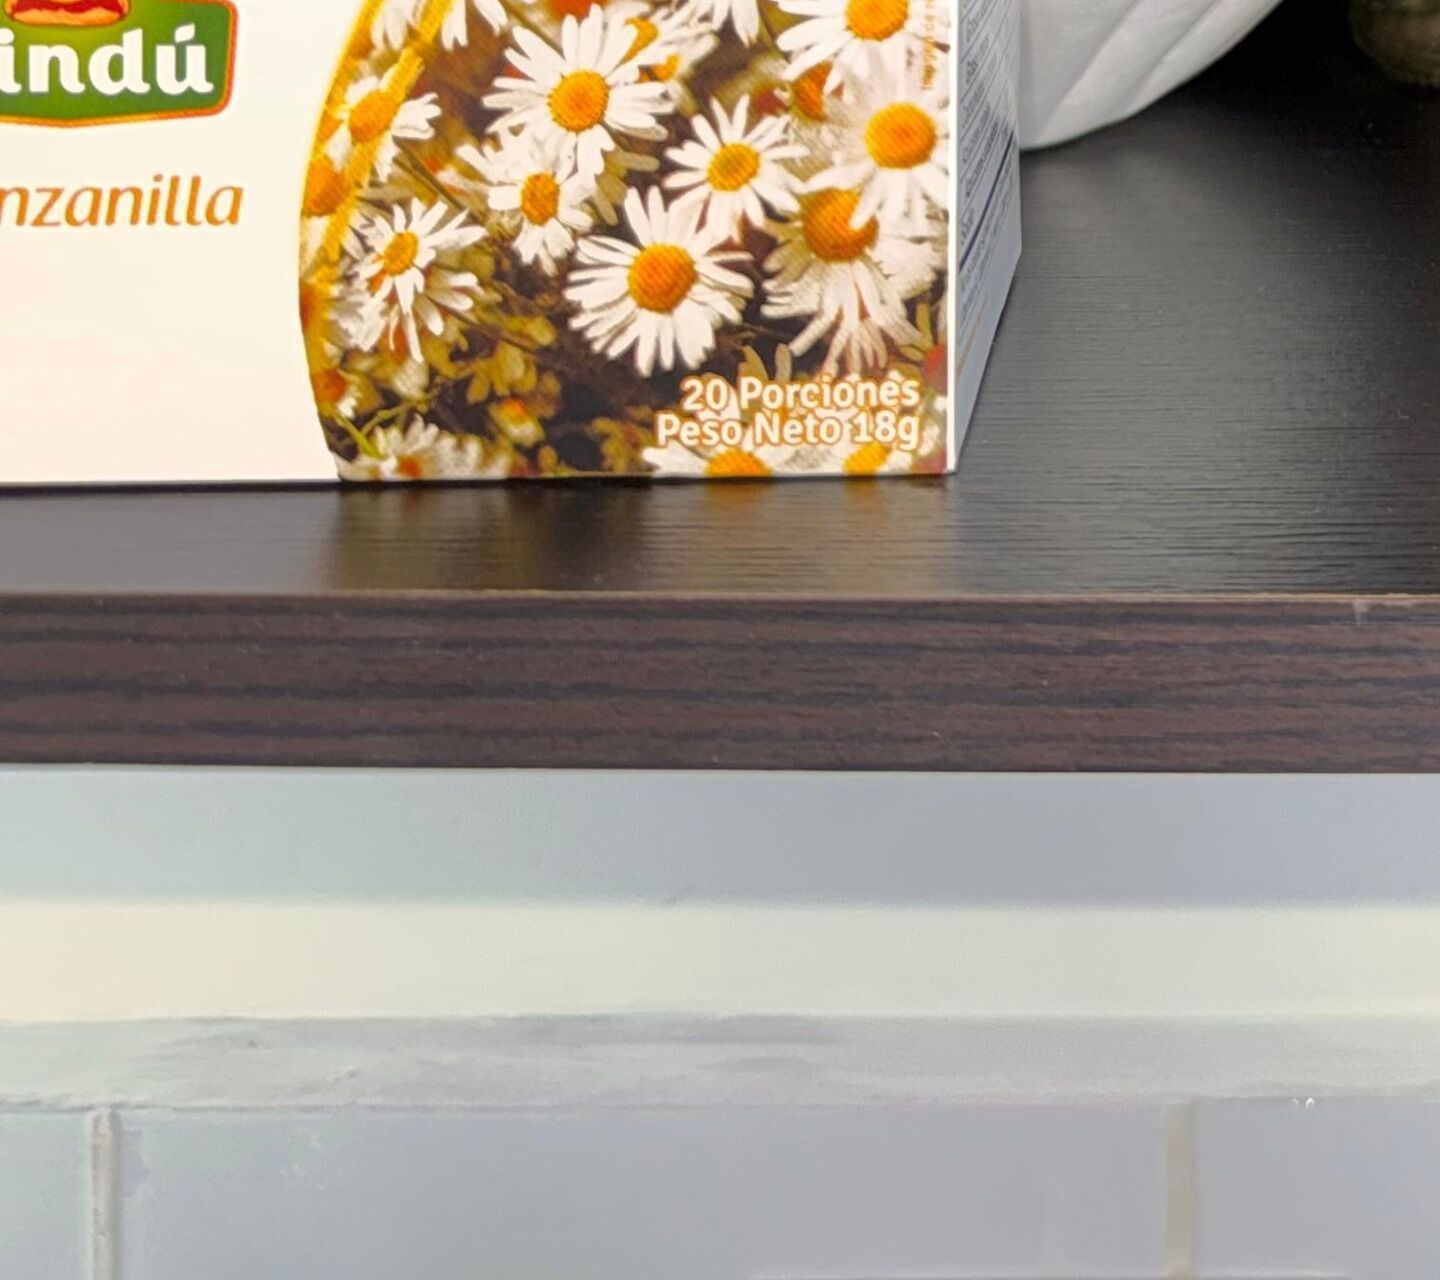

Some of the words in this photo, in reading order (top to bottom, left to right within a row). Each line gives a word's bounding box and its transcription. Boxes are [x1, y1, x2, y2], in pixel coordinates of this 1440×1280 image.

[682, 379, 728, 411] 20
[740, 373, 920, 409] Porciones
[657, 414, 742, 445] Peso
[755, 412, 843, 444] Neto
[851, 410, 920, 450] 18g
